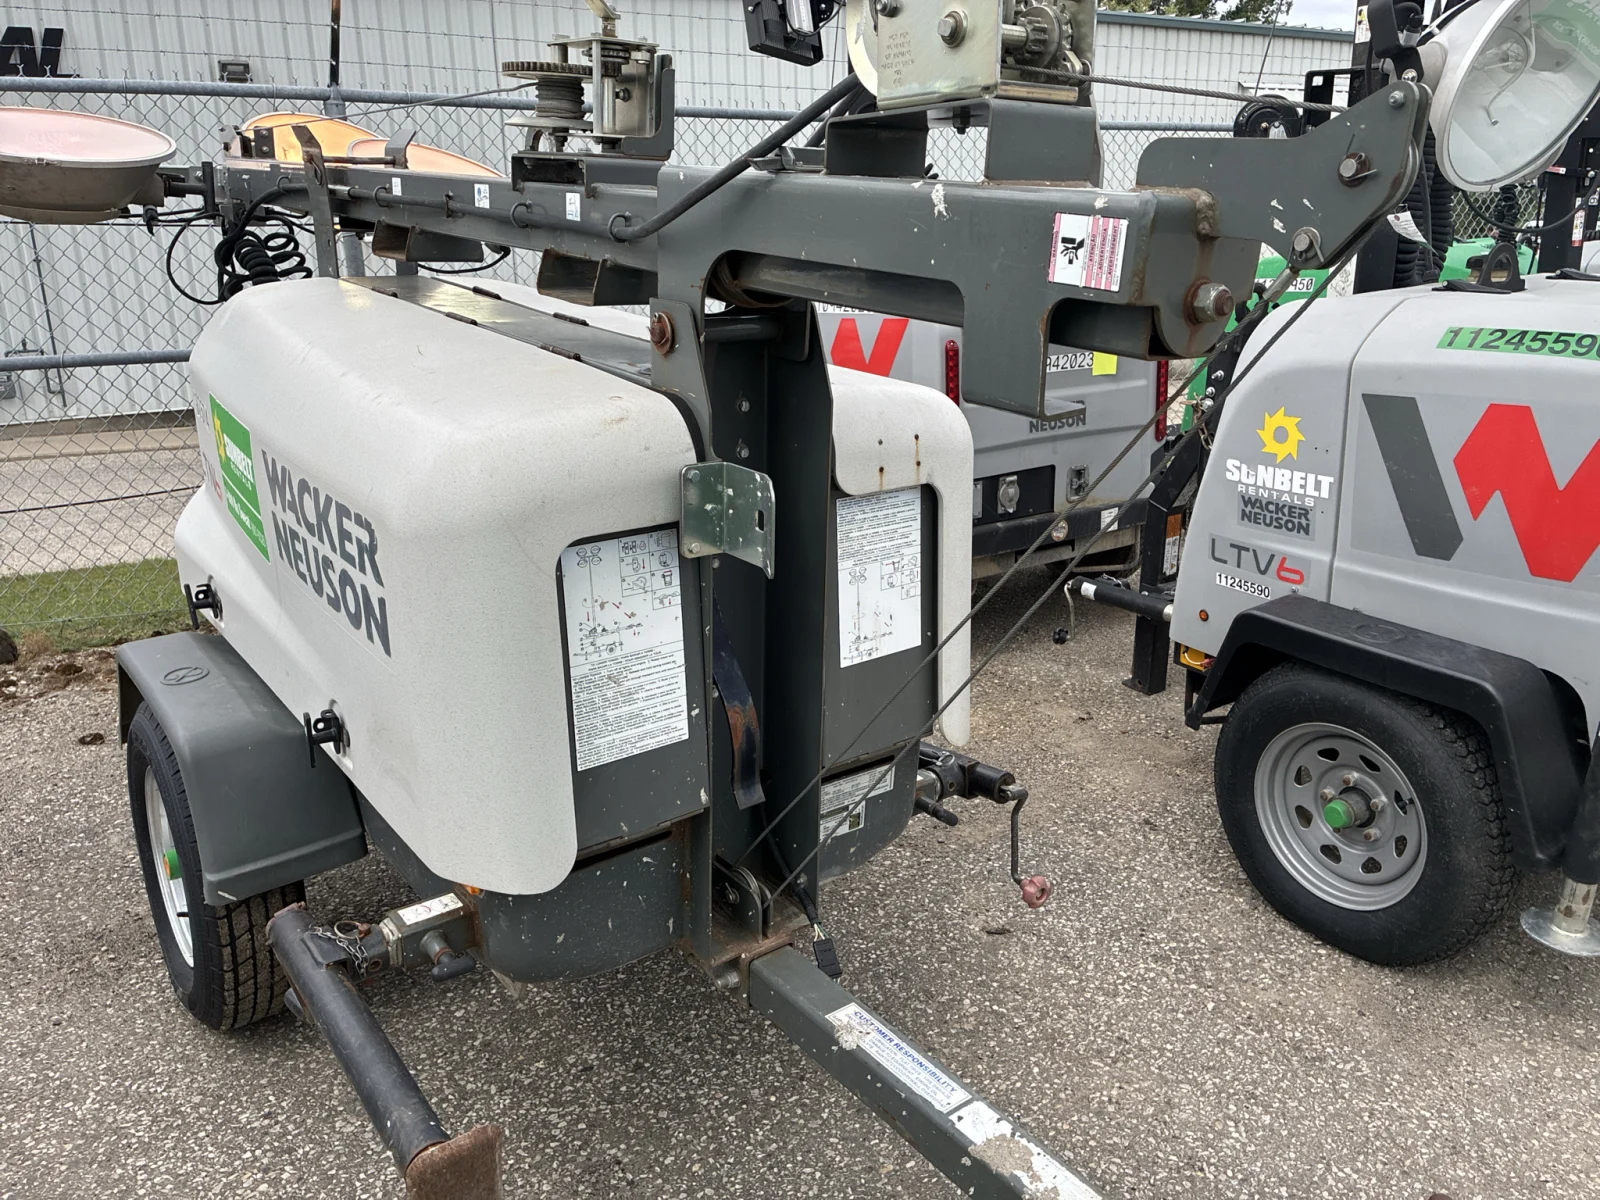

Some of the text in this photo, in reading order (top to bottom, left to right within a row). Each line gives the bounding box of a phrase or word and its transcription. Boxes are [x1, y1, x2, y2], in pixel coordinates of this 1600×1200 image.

[1448, 326, 1600, 359] 1124559
[1029, 413, 1087, 433] NEUSON
[1225, 458, 1334, 499] SUNBELT
[1237, 483, 1315, 507] RENTALS
[261, 448, 385, 588] WACKER
[1241, 495, 1310, 522] WACKER
[1241, 510, 1310, 536] NEUSON
[1211, 538, 1305, 585] LTV6
[271, 510, 391, 658] NEUSON
[1217, 573, 1271, 598] 11245590
[852, 1010, 895, 1043] CUSTOMER
[892, 1042, 958, 1093] RESPONSIBILITY
